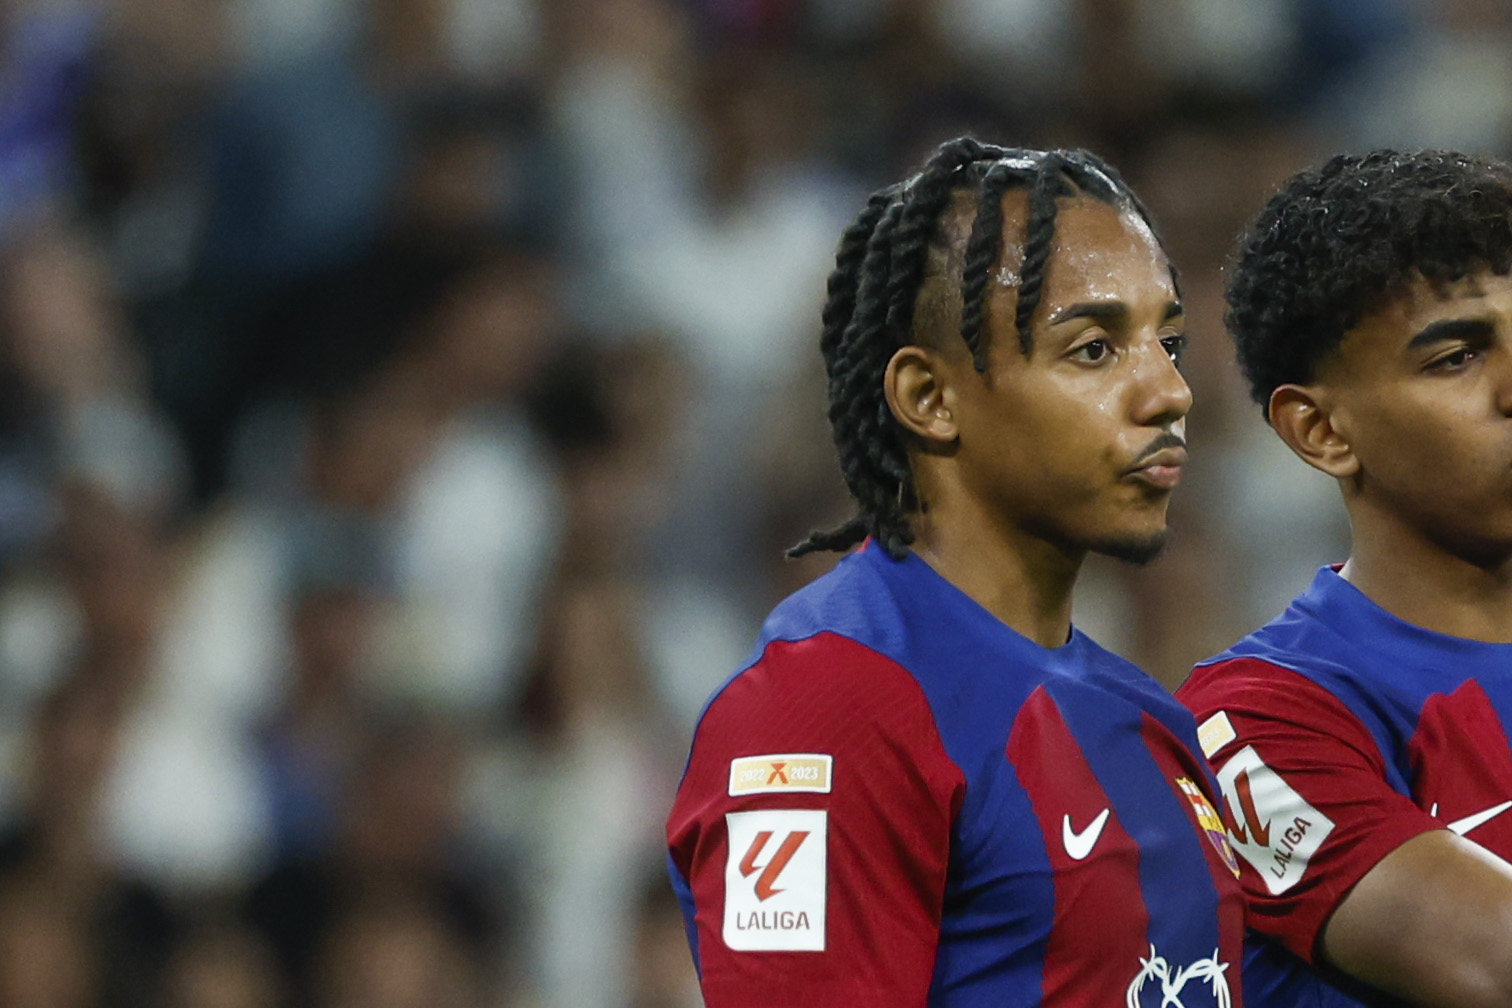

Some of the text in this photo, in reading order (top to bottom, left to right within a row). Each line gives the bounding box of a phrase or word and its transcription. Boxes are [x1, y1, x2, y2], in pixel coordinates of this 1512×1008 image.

[790, 766, 819, 781] 2023
[1270, 816, 1312, 879] LALIGA
[736, 910, 811, 931] LALIGA
